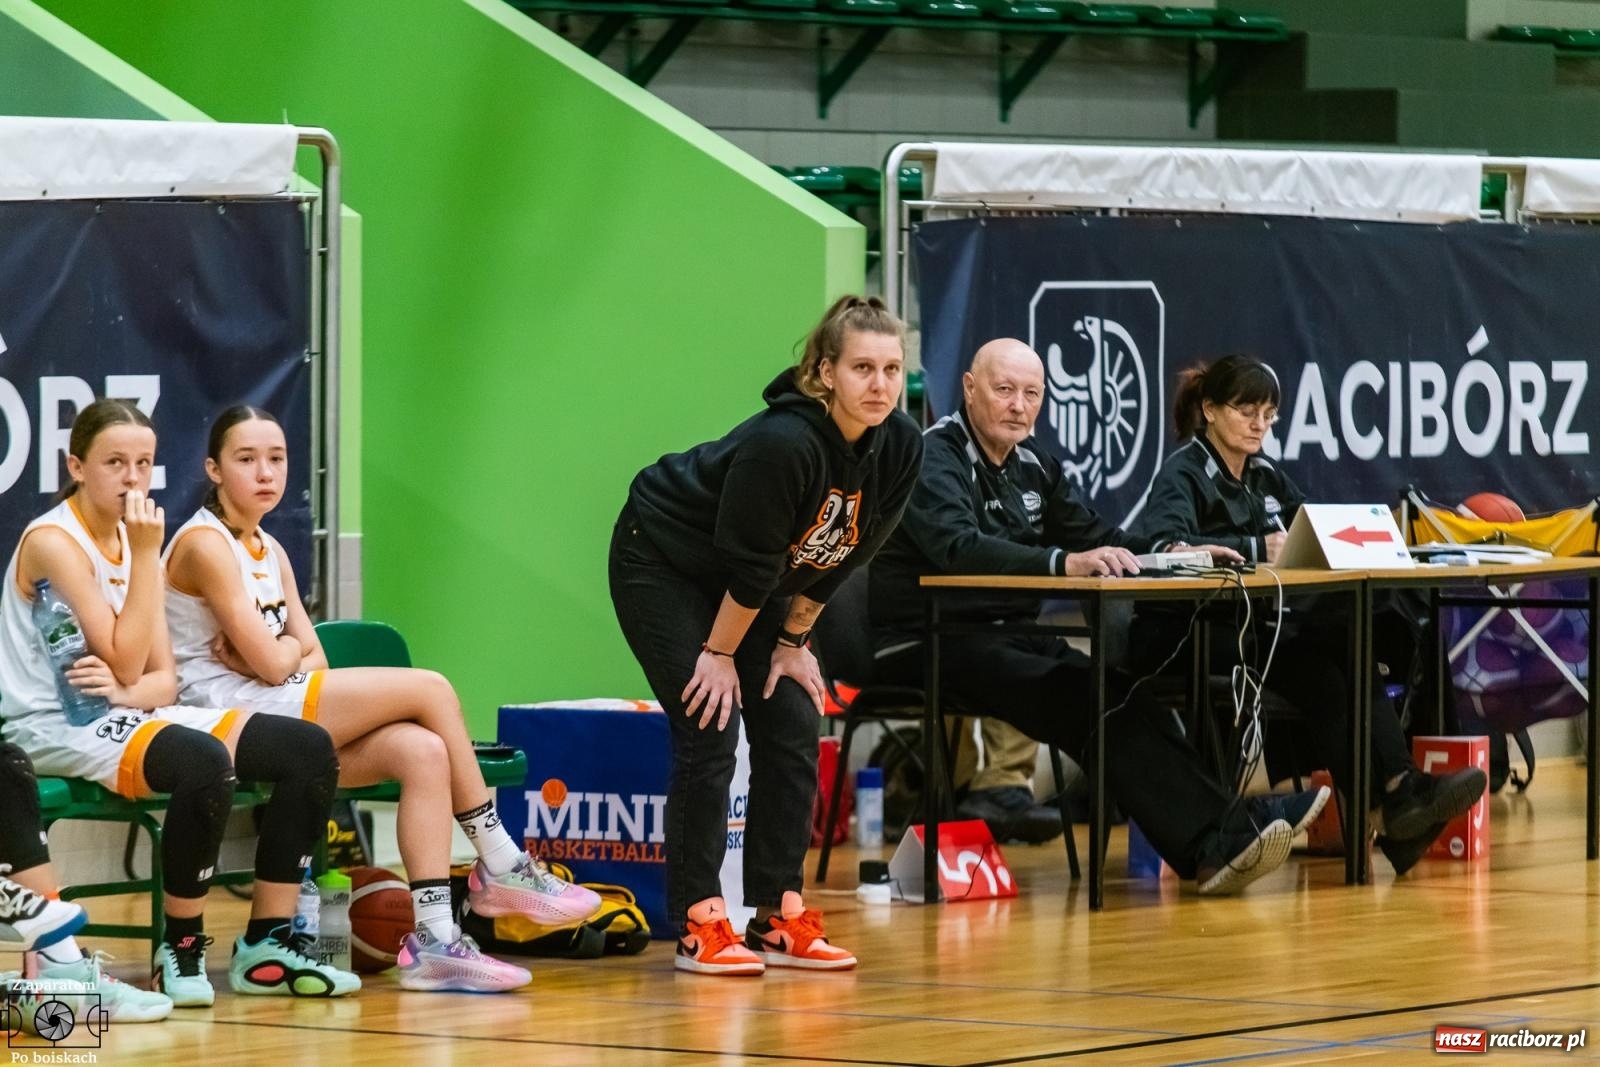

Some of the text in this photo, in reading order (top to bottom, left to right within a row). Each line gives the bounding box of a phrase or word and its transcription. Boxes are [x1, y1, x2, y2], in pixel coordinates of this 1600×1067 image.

[1261, 325, 1590, 462] ACIBÓRZ
[524, 790, 667, 843] MINI
[525, 837, 666, 863] BASKETBALL
